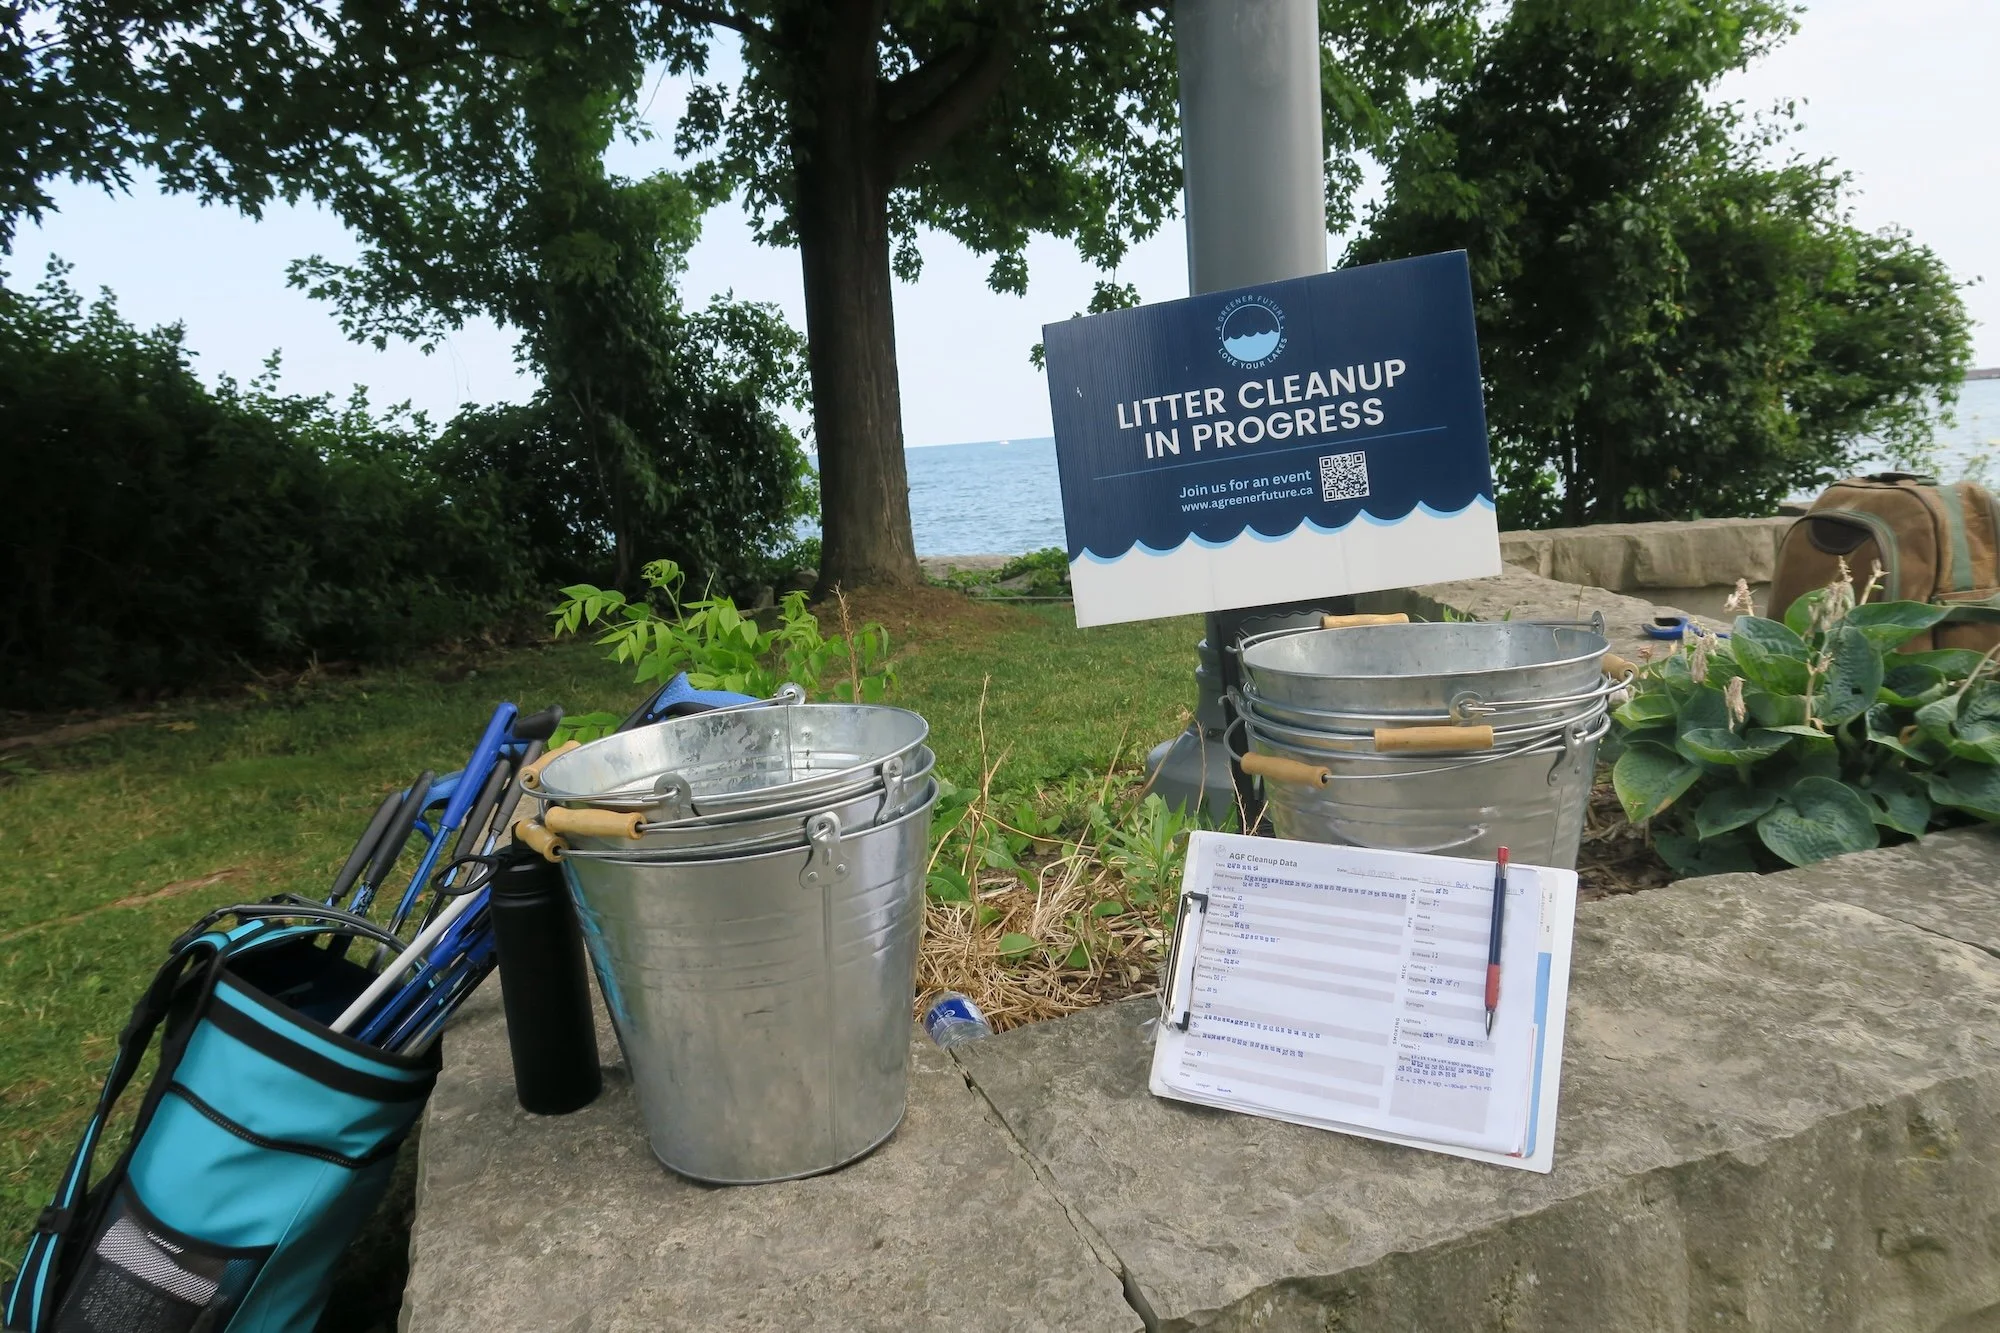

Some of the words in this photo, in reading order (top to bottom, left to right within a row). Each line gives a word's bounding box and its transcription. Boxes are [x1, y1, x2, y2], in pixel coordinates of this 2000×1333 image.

[1218, 295, 1253, 322] GREENER
[1257, 296, 1285, 320] FUTURE
[1218, 348, 1238, 366] LOVE
[1240, 360, 1265, 369] YOUR
[1267, 338, 1287, 363] LAKES
[1117, 387, 1226, 430] LITTER
[1237, 358, 1407, 409] CLEANUP
[1144, 427, 1181, 459] IN
[1191, 397, 1385, 451] PROGRESS
[1179, 484, 1208, 499] Join
[1211, 481, 1226, 494] us
[1229, 478, 1247, 491] for
[1252, 476, 1269, 489] an
[1272, 469, 1312, 486] event
[1181, 485, 1314, 512] www.agreenerfuture.ca
[1229, 852, 1245, 860] AGF
[1247, 855, 1278, 866] Cleanup
[1280, 859, 1298, 867] Data
[1392, 1018, 1400, 1044] SMOKING
